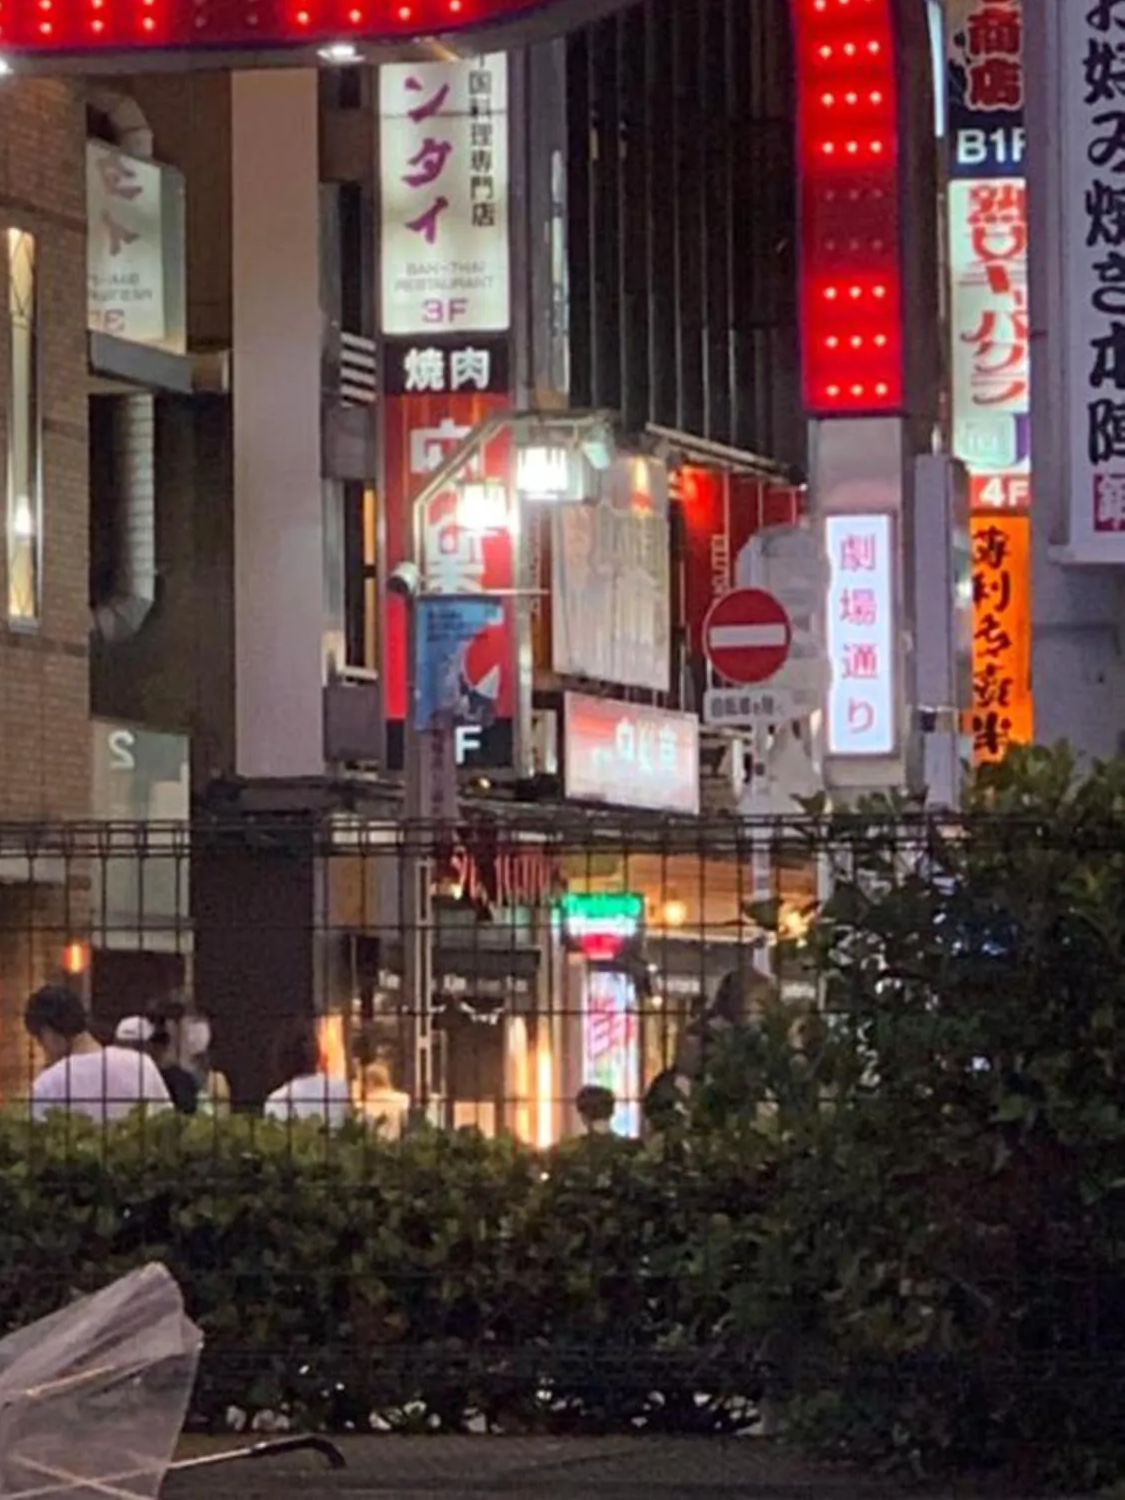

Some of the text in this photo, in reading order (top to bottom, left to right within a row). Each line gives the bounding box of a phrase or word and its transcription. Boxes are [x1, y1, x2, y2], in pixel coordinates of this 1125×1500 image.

[401, 76, 453, 244] ンタイ
[422, 298, 468, 323] 3F
[404, 348, 490, 390] 焼肉
[979, 477, 1028, 507] 4F
[838, 534, 876, 735] 劇場通り
